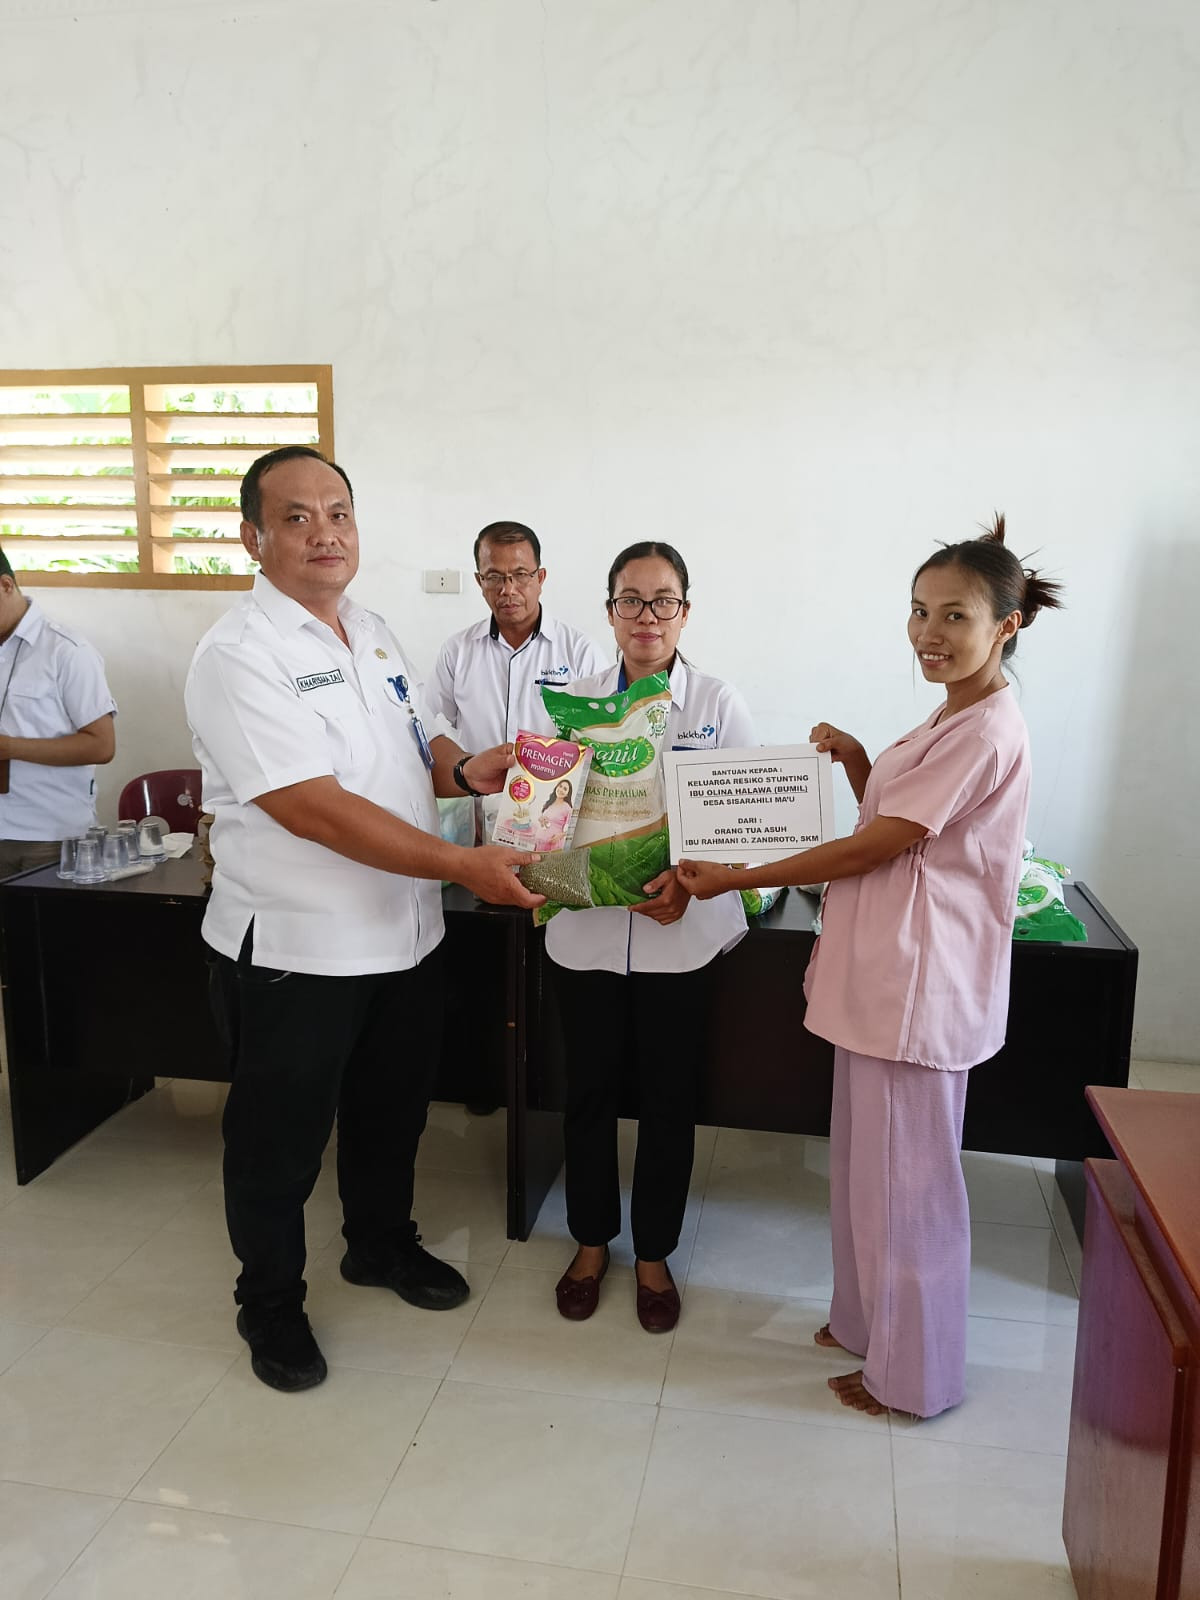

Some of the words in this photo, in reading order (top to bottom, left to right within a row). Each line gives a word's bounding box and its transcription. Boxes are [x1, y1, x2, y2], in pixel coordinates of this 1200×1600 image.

[300, 675, 330, 688] KHARISMA
[677, 730, 706, 739] bkkbn
[521, 747, 573, 769] PRENAGEN
[530, 763, 556, 776] mommy
[712, 768, 747, 776] BANTUAN
[687, 779, 731, 787] KELUARGA
[733, 777, 764, 785] RESIKO
[765, 774, 809, 783] STUNTING
[602, 787, 648, 798] PREMIUM
[689, 789, 704, 797] IBU
[706, 788, 733, 796] OLINA
[735, 786, 772, 795] HALAWA
[774, 785, 808, 794] (BUMIL)
[726, 797, 773, 805] SISARAHILI
[701, 837, 739, 845] RAHMANI
[751, 836, 798, 844] ZANDROTO,
